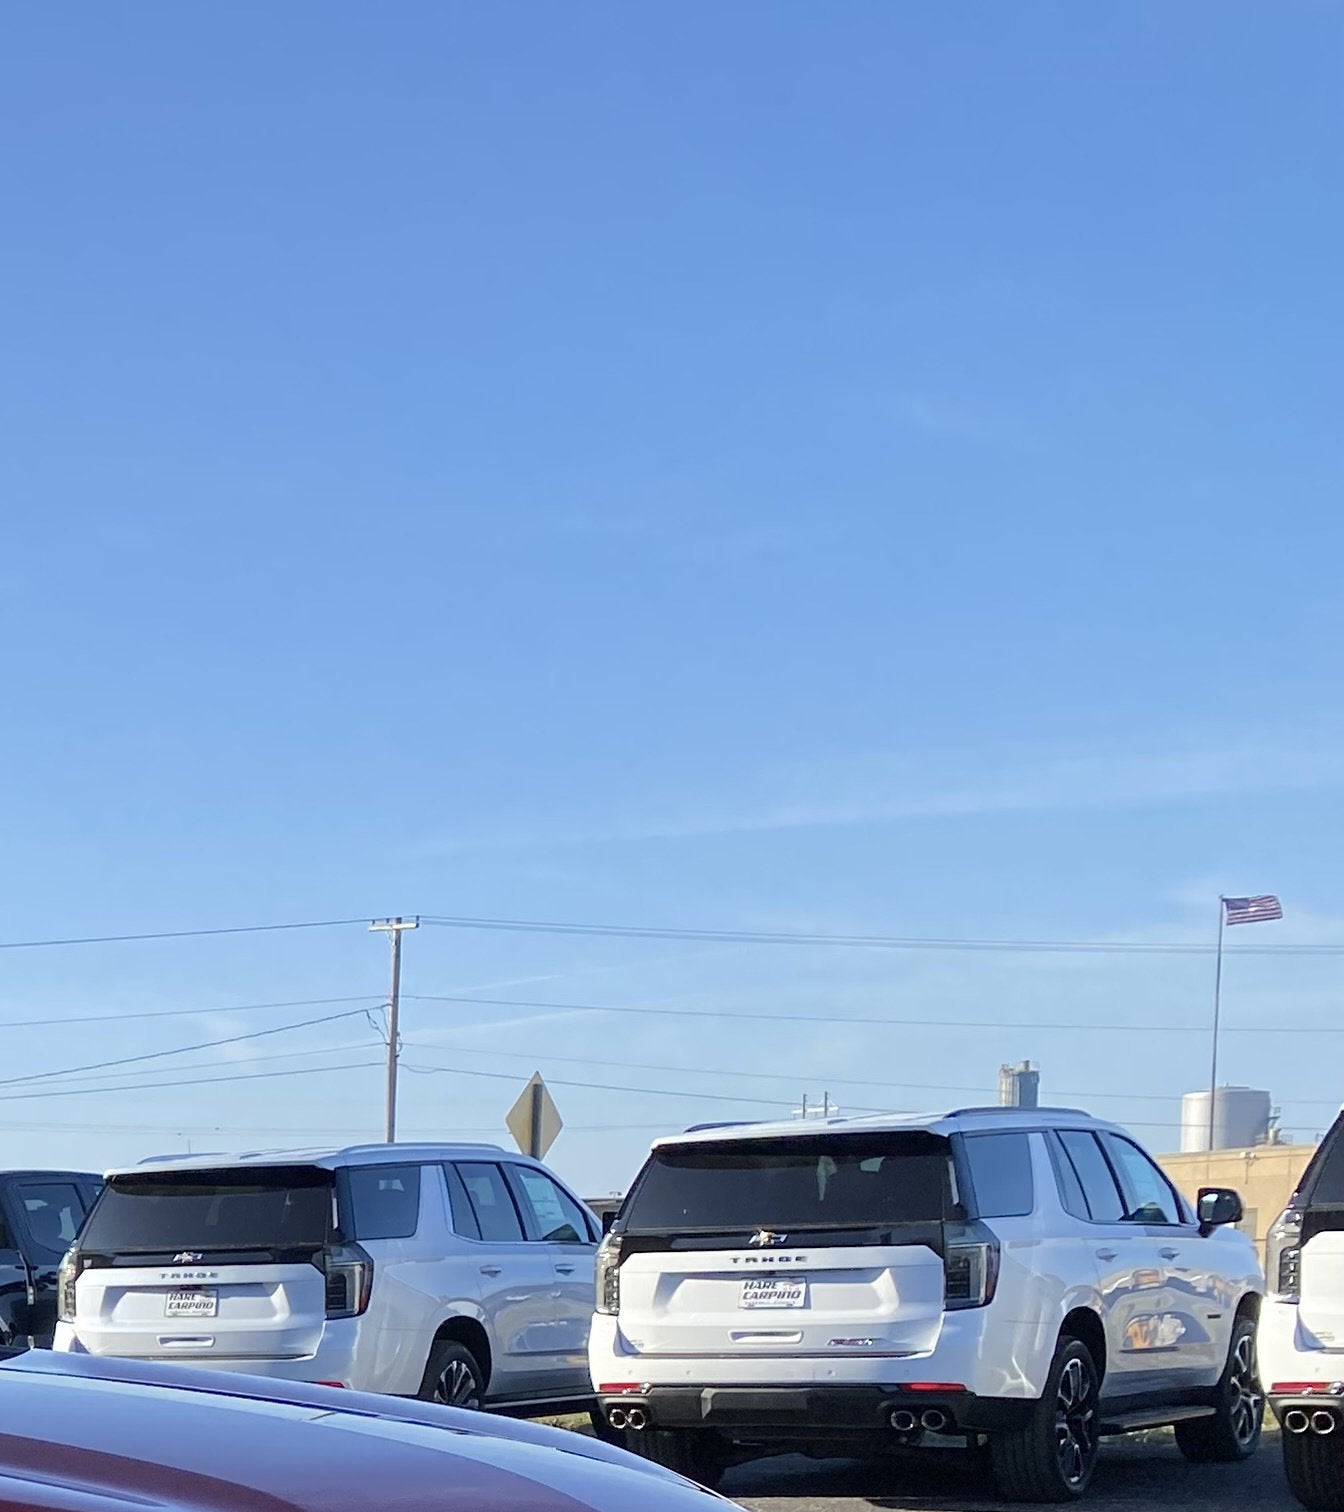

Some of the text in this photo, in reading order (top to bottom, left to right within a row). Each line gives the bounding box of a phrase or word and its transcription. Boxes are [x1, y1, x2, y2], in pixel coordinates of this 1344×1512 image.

[730, 1256, 809, 1264] TAHOE
[743, 1281, 778, 1290] HARE
[742, 1290, 802, 1300] CARPINO
